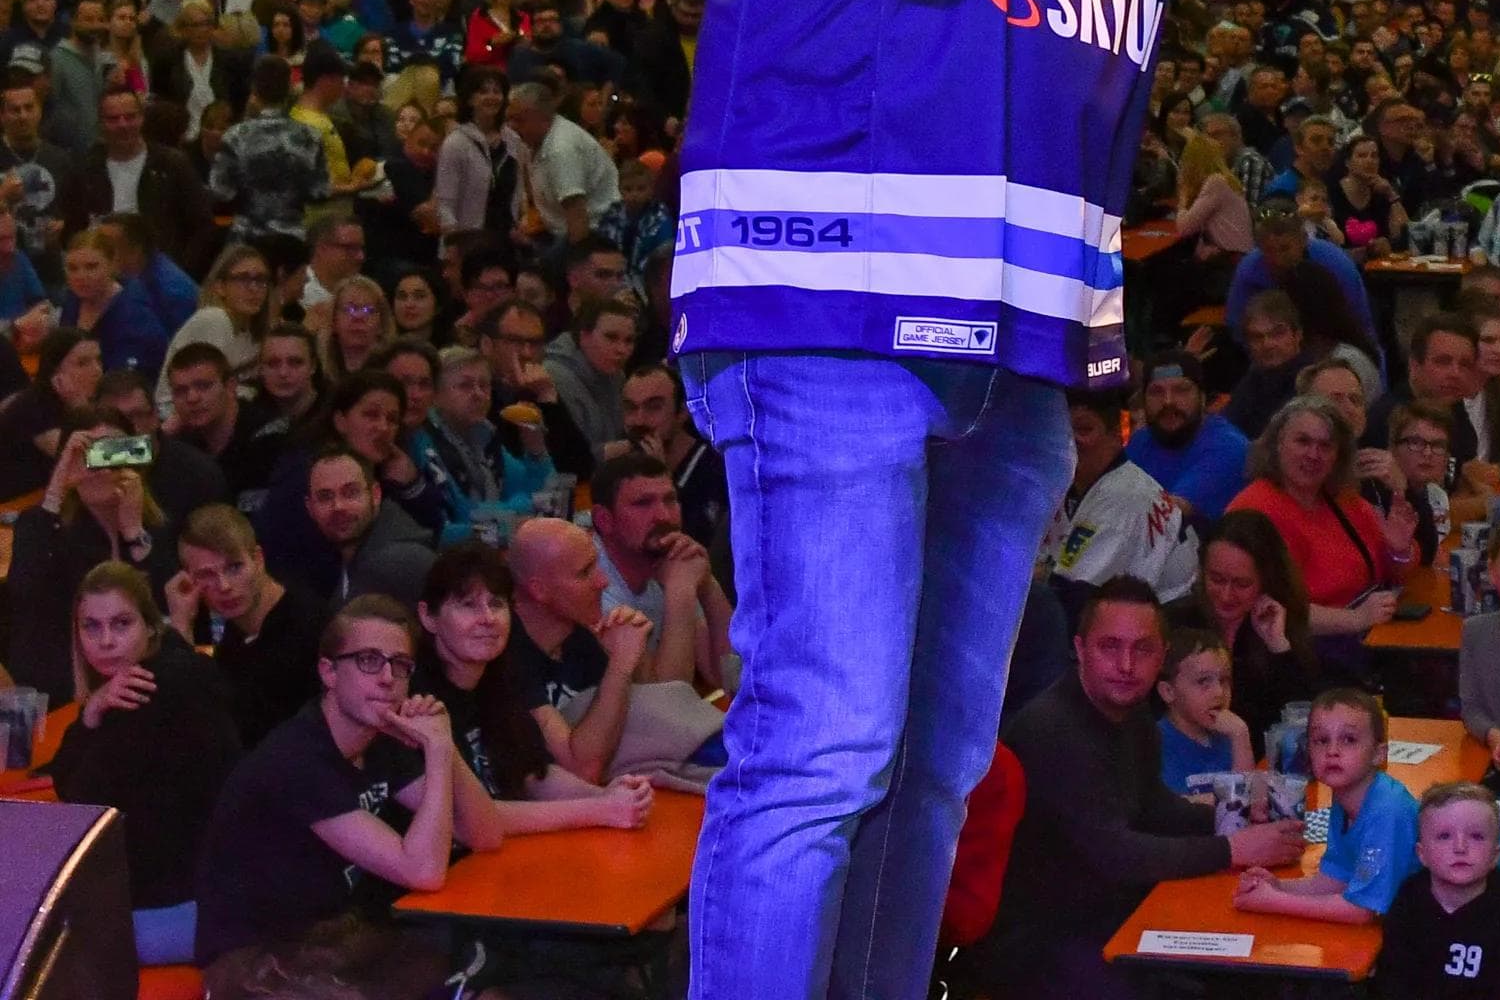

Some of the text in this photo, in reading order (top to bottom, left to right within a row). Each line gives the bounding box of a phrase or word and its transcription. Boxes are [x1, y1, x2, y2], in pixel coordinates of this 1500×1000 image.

[731, 216, 853, 247] 1964
[903, 334, 966, 346] GAME JERSEY
[915, 325, 955, 336] OFFICIAL
[1444, 943, 1483, 978] 39
